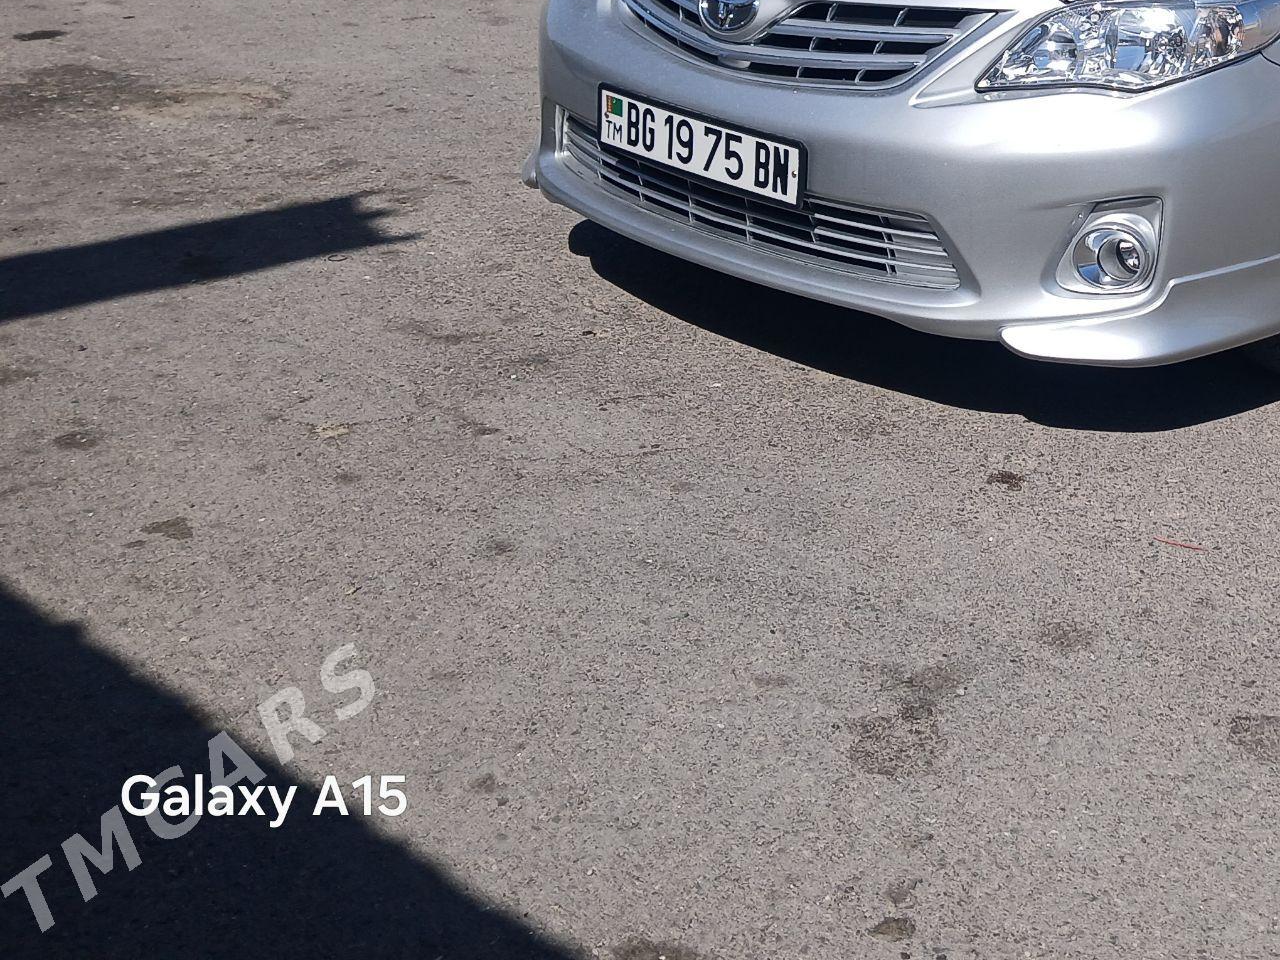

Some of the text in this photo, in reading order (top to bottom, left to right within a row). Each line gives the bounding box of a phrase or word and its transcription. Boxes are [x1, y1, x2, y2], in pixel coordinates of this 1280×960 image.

[605, 119, 623, 143] TM
[626, 101, 790, 196] BG 19 75 BN
